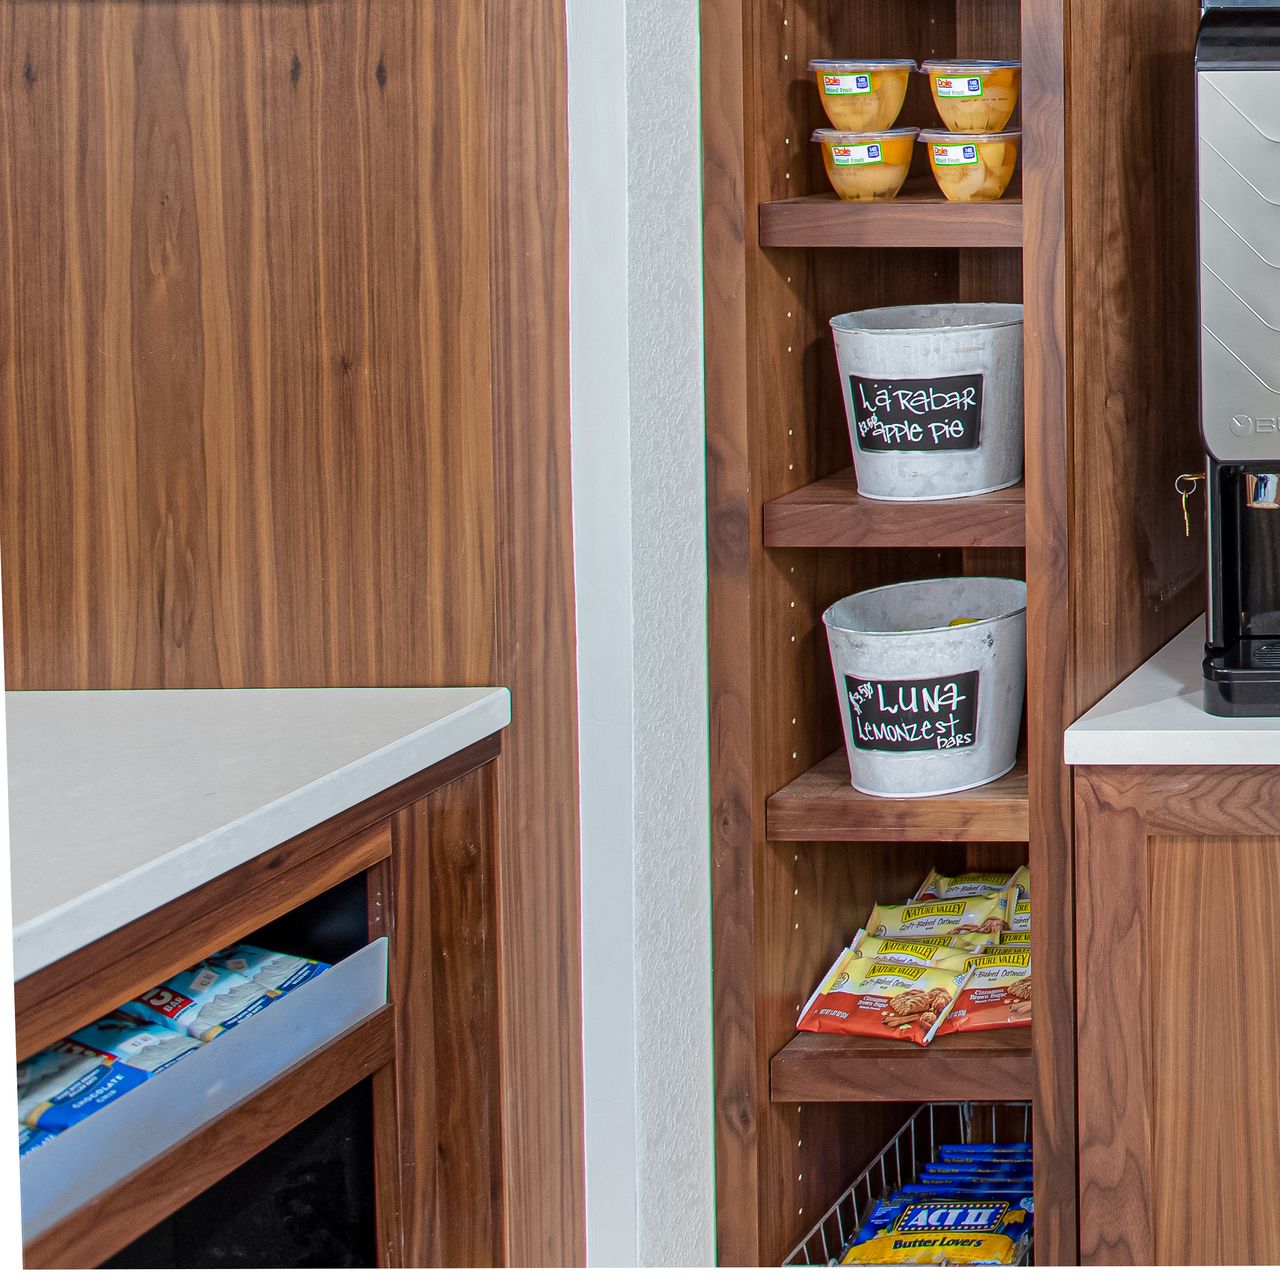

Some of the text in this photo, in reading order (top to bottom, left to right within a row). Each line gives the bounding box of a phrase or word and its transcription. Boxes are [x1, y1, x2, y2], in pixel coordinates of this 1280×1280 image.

[164, 995, 185, 1013] BAR
[908, 1209, 963, 1227] ACT
[893, 1236, 983, 1250] Butter Lovers
